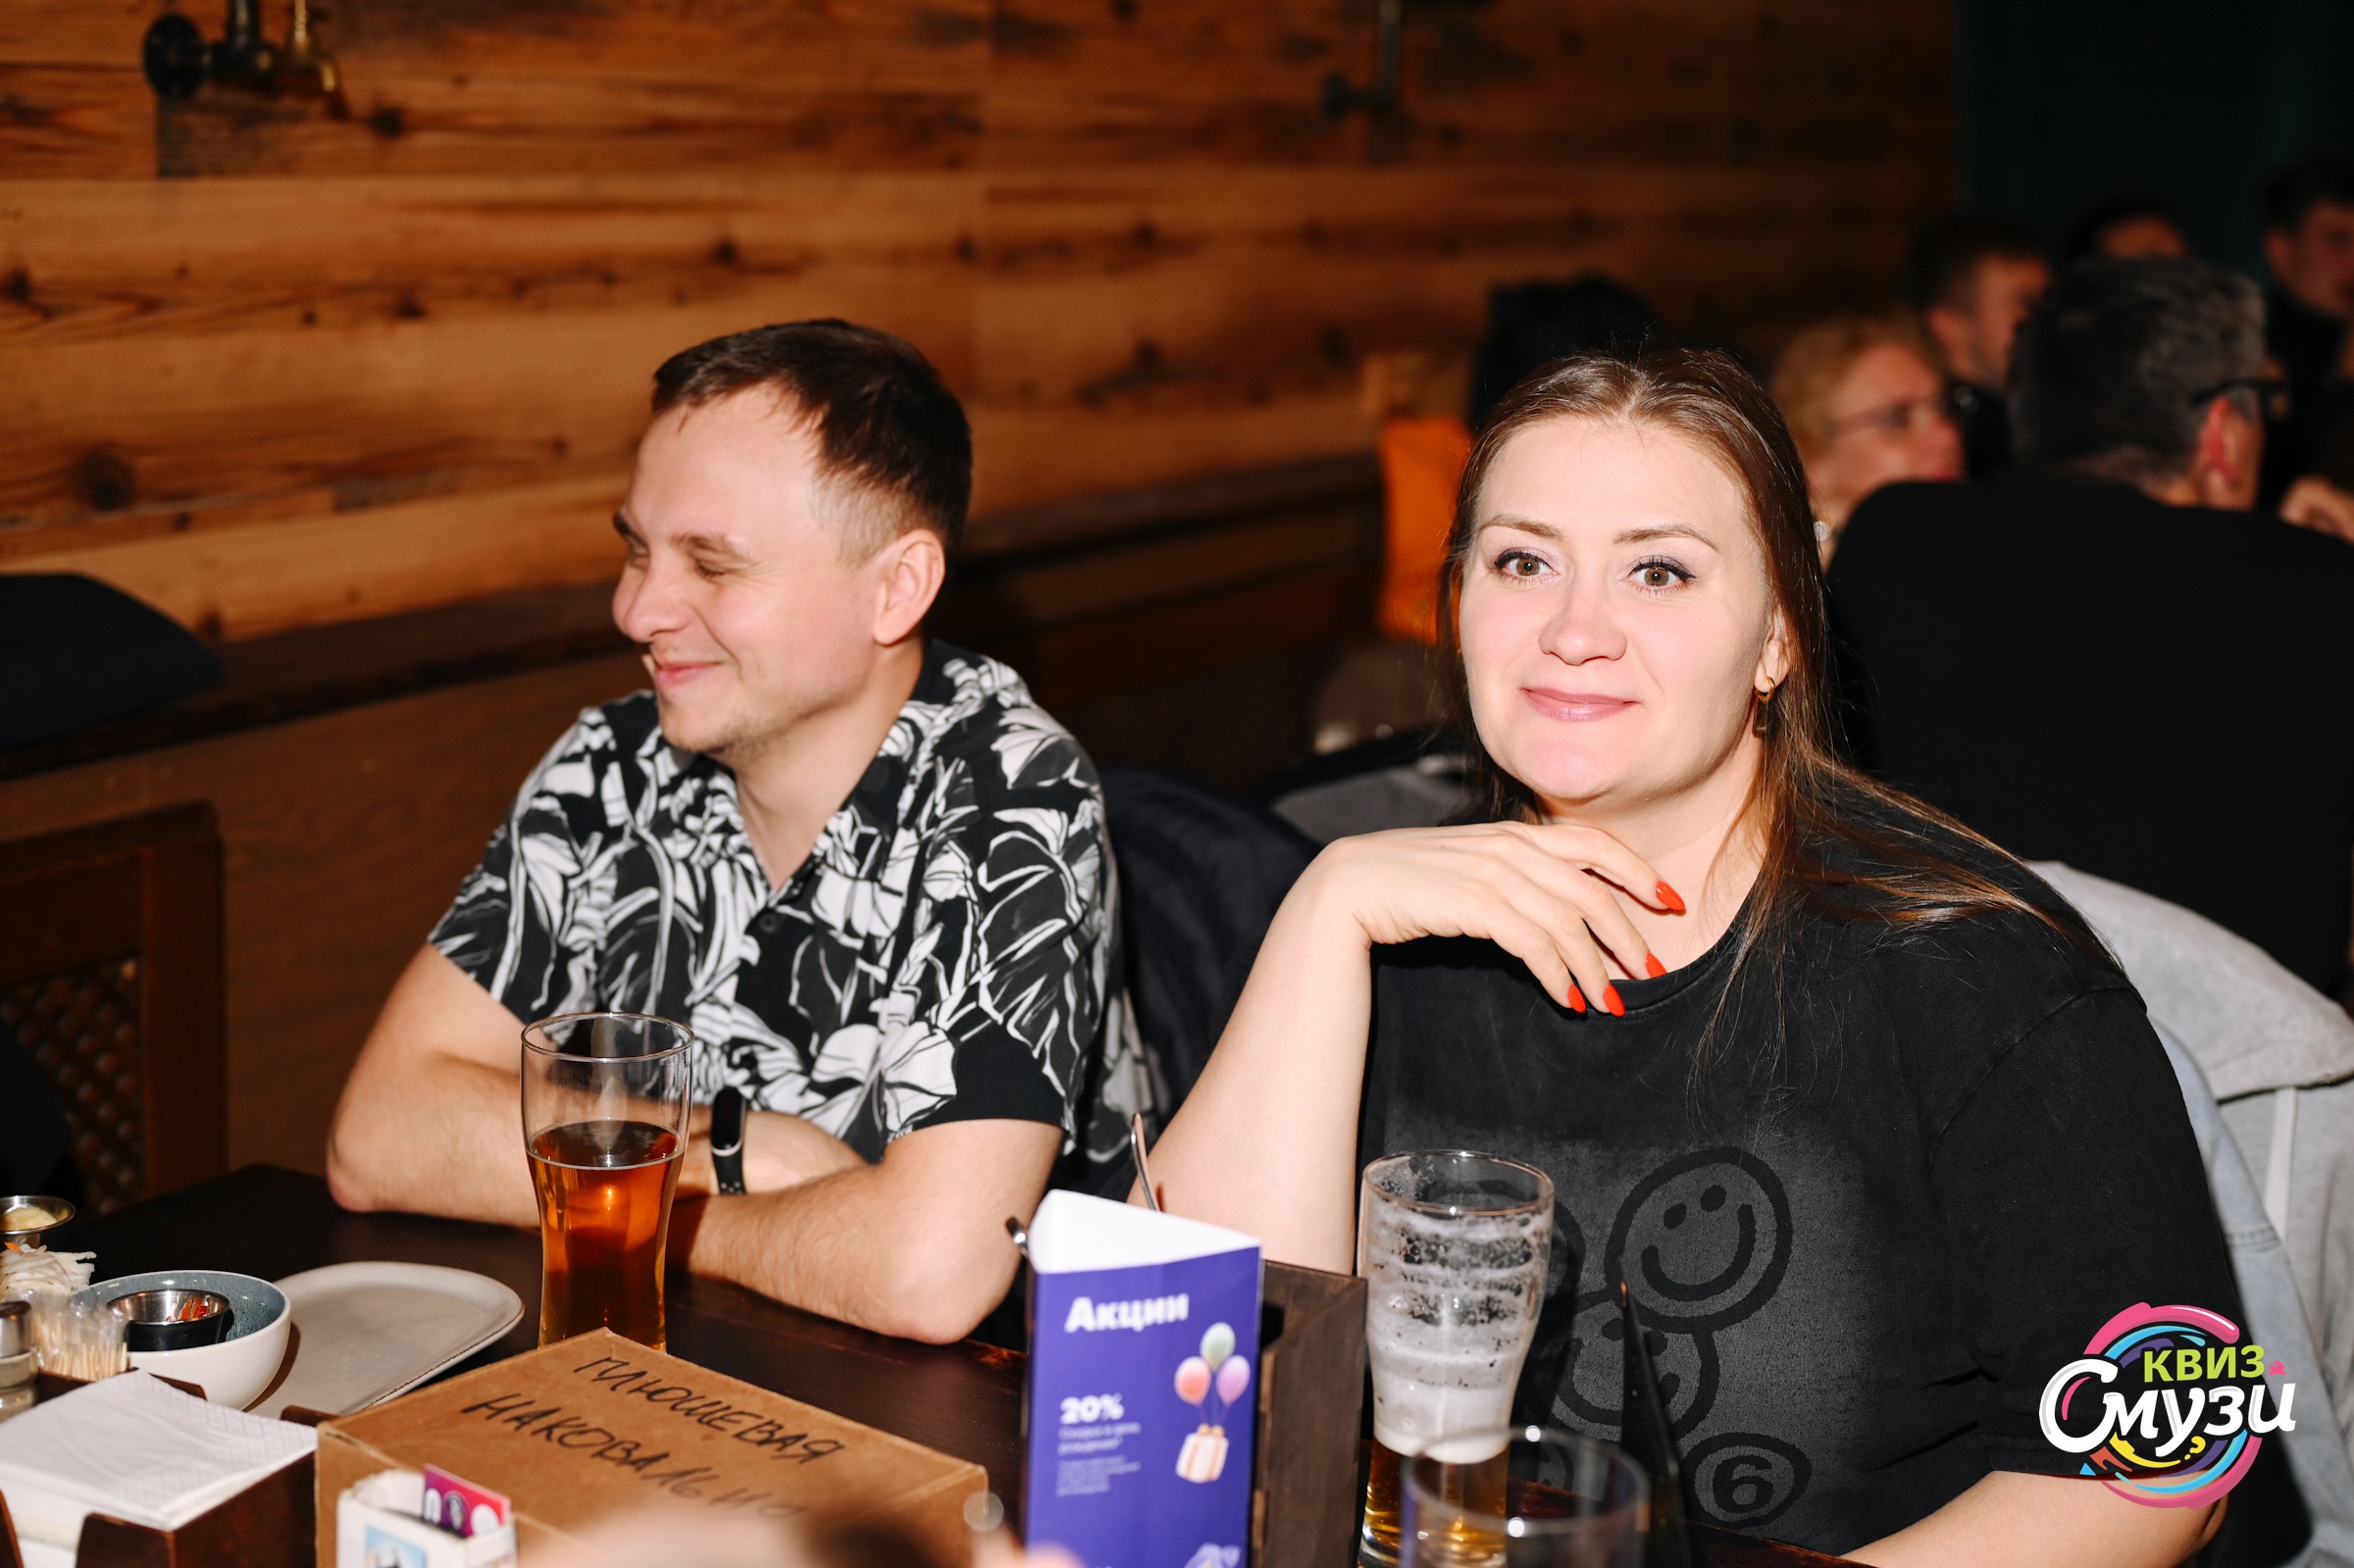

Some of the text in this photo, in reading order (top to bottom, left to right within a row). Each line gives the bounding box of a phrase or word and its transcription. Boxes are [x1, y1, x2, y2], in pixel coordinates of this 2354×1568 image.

[1064, 1293, 1190, 1333] Акции
[574, 1356, 845, 1464] ПЛЮШЕВАЯ
[1059, 1392, 1125, 1424] 20%
[1711, 1454, 1778, 1514] 6
